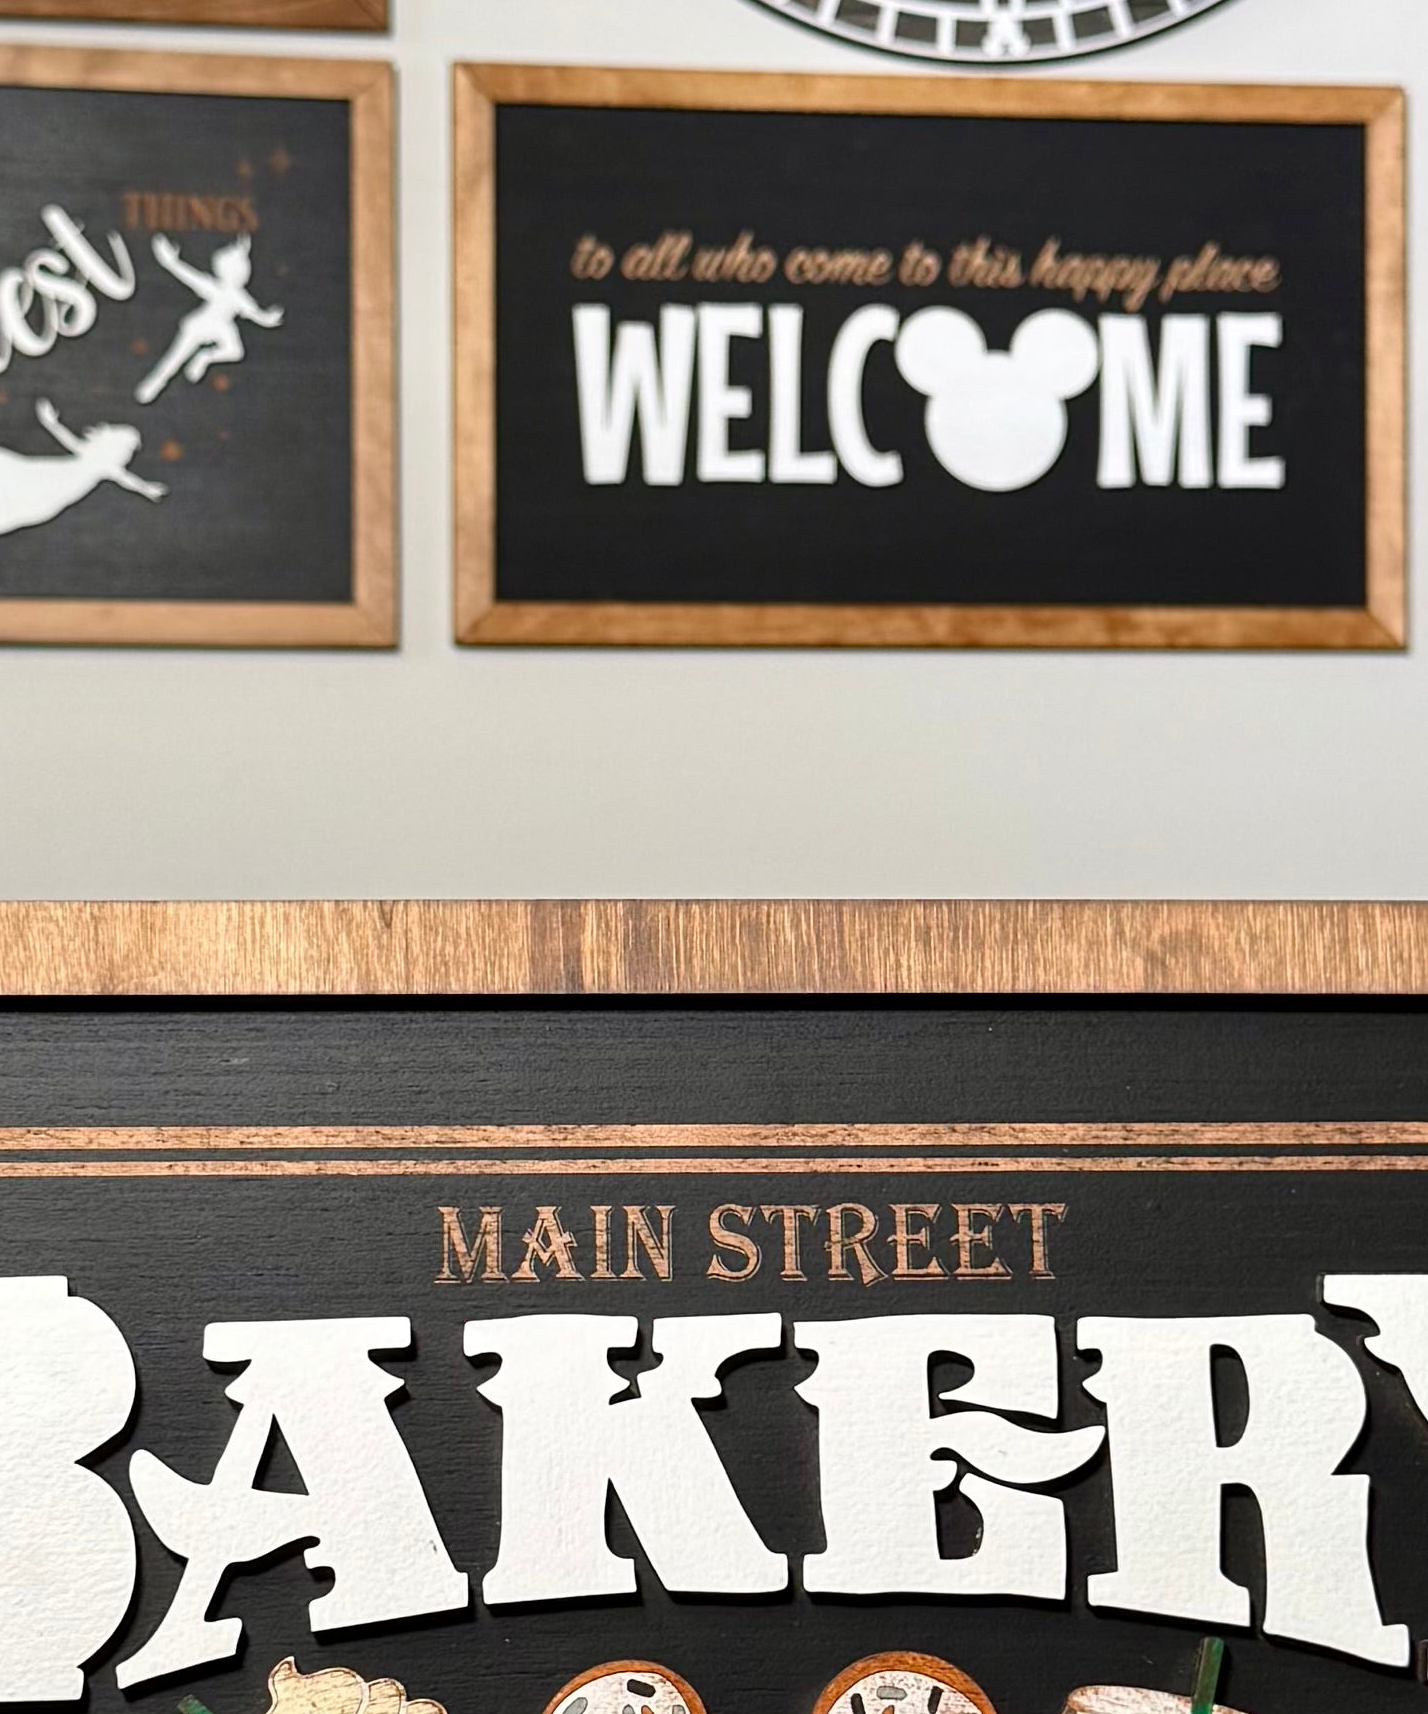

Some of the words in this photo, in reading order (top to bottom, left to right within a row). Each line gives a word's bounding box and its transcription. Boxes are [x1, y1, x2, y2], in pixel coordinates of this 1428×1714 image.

[120, 190, 258, 232] THINGS
[571, 233, 614, 282] to
[619, 230, 689, 281] all
[690, 230, 775, 283] who
[783, 242, 893, 285] come
[897, 239, 942, 286] to
[947, 234, 1023, 288] this
[1027, 234, 1161, 311] happy
[1158, 241, 1281, 303] place
[572, 301, 1285, 492] WELCME
[433, 1203, 677, 1284] MAIN
[705, 1202, 1071, 1288] STREET
